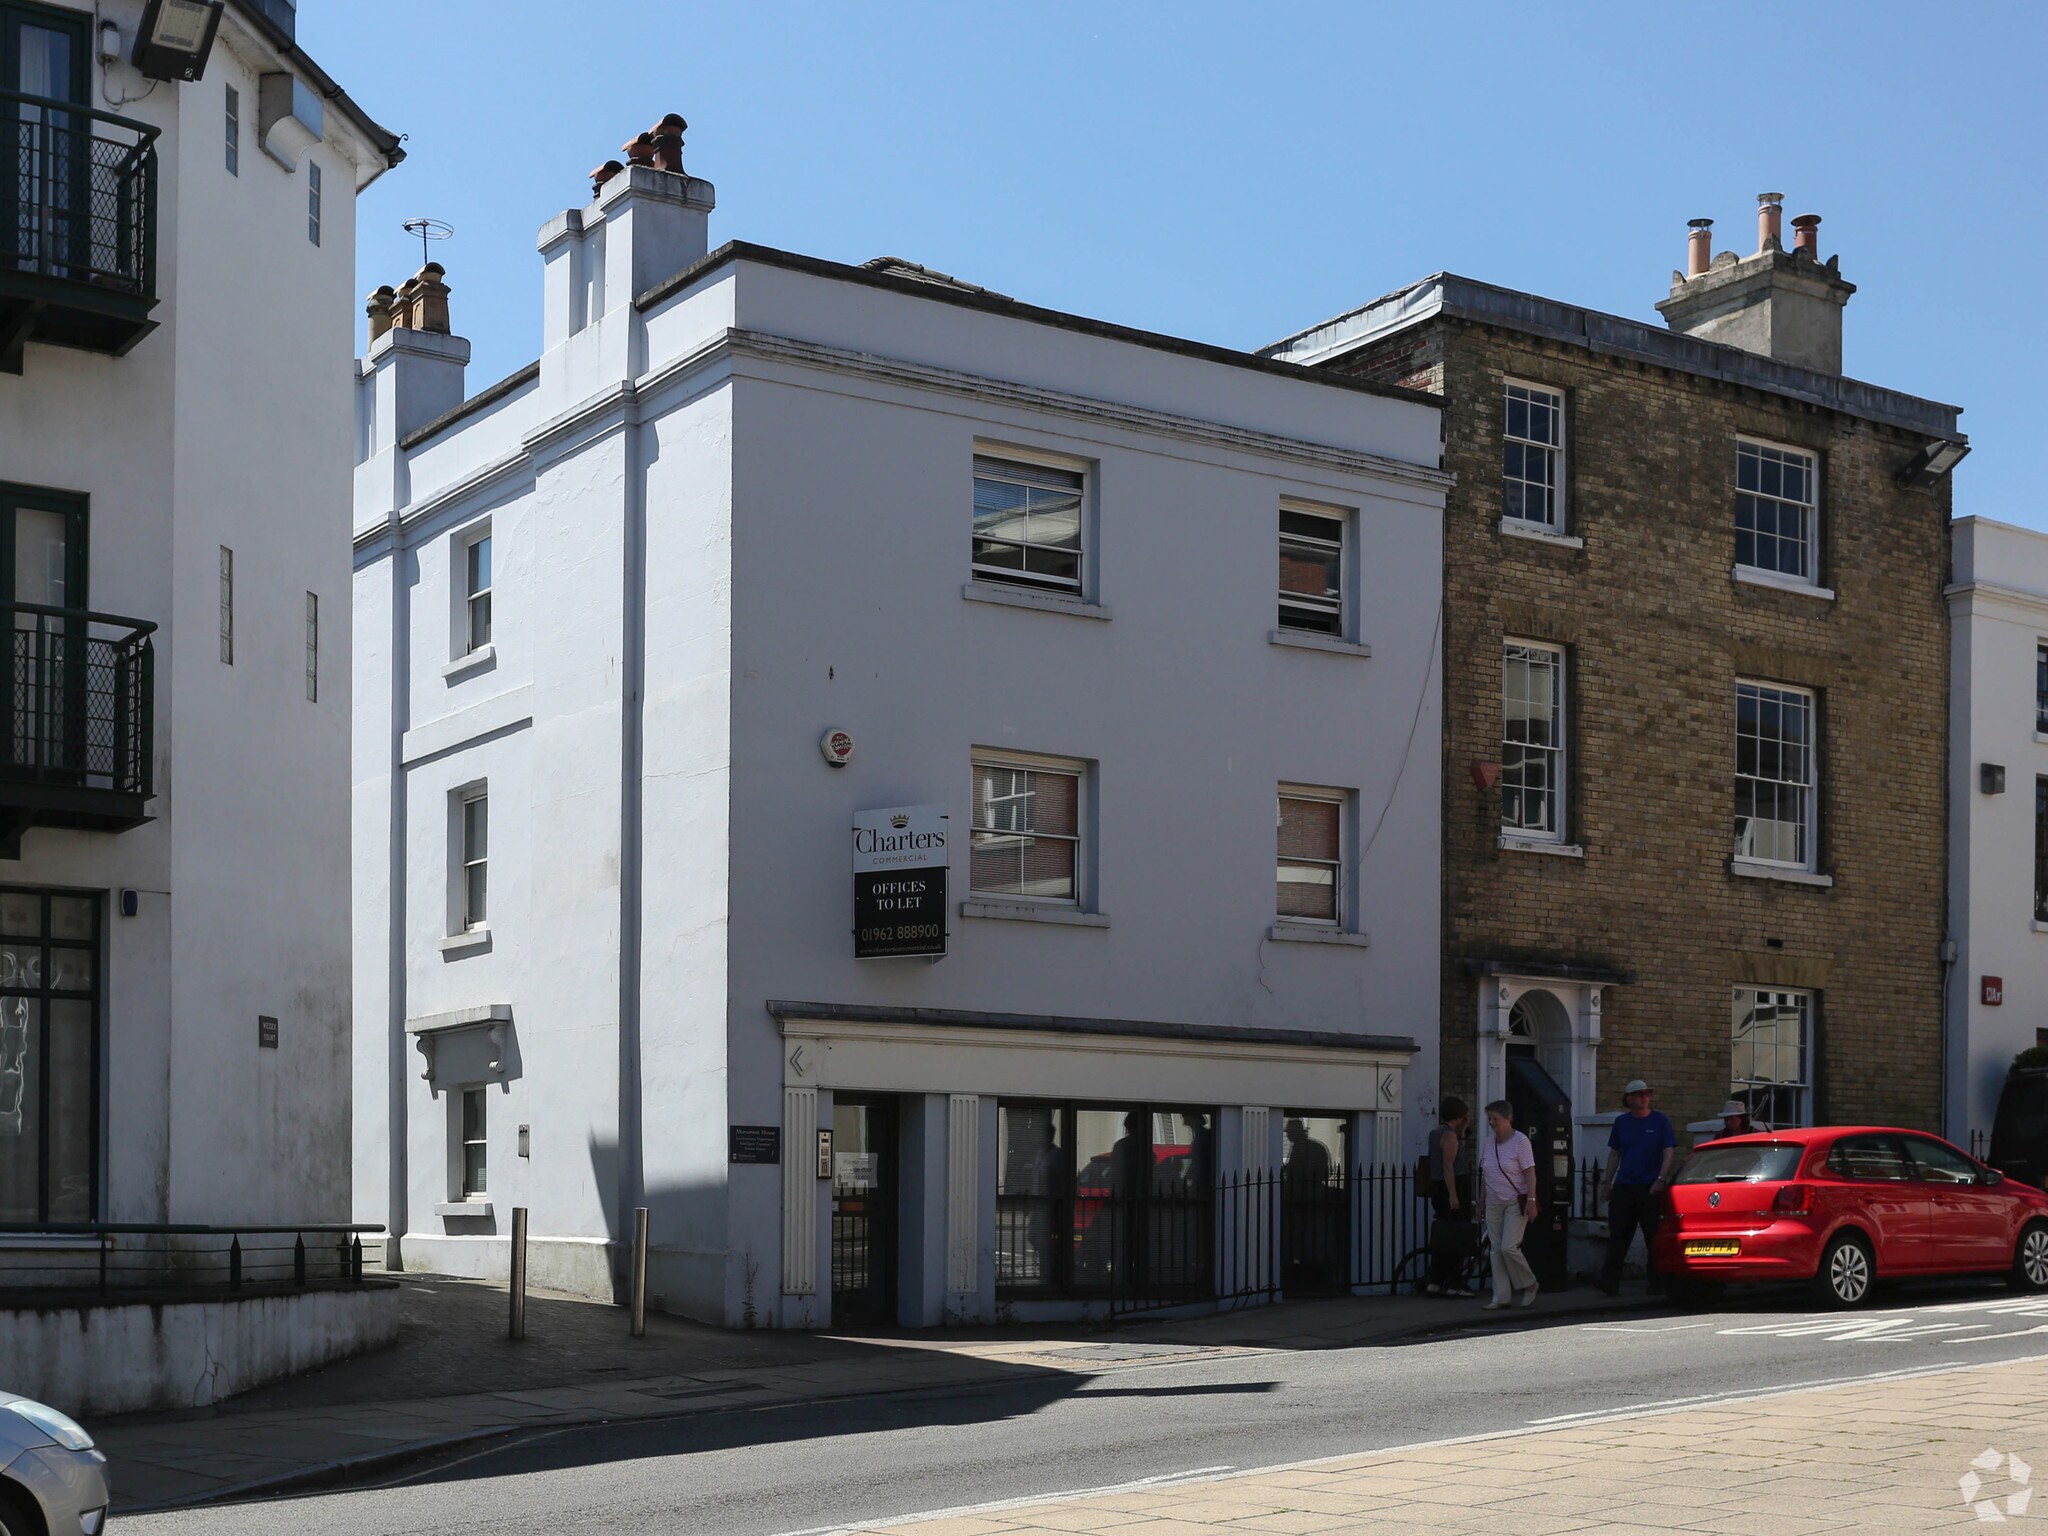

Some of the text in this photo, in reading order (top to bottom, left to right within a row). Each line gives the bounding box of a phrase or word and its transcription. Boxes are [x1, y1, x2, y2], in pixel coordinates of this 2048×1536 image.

[855, 828, 945, 854] Charters
[872, 854, 928, 865] COMMERCIAL
[872, 880, 926, 895] OFFICES
[876, 896, 922, 911] TO LET
[861, 923, 939, 942] 01962 888900
